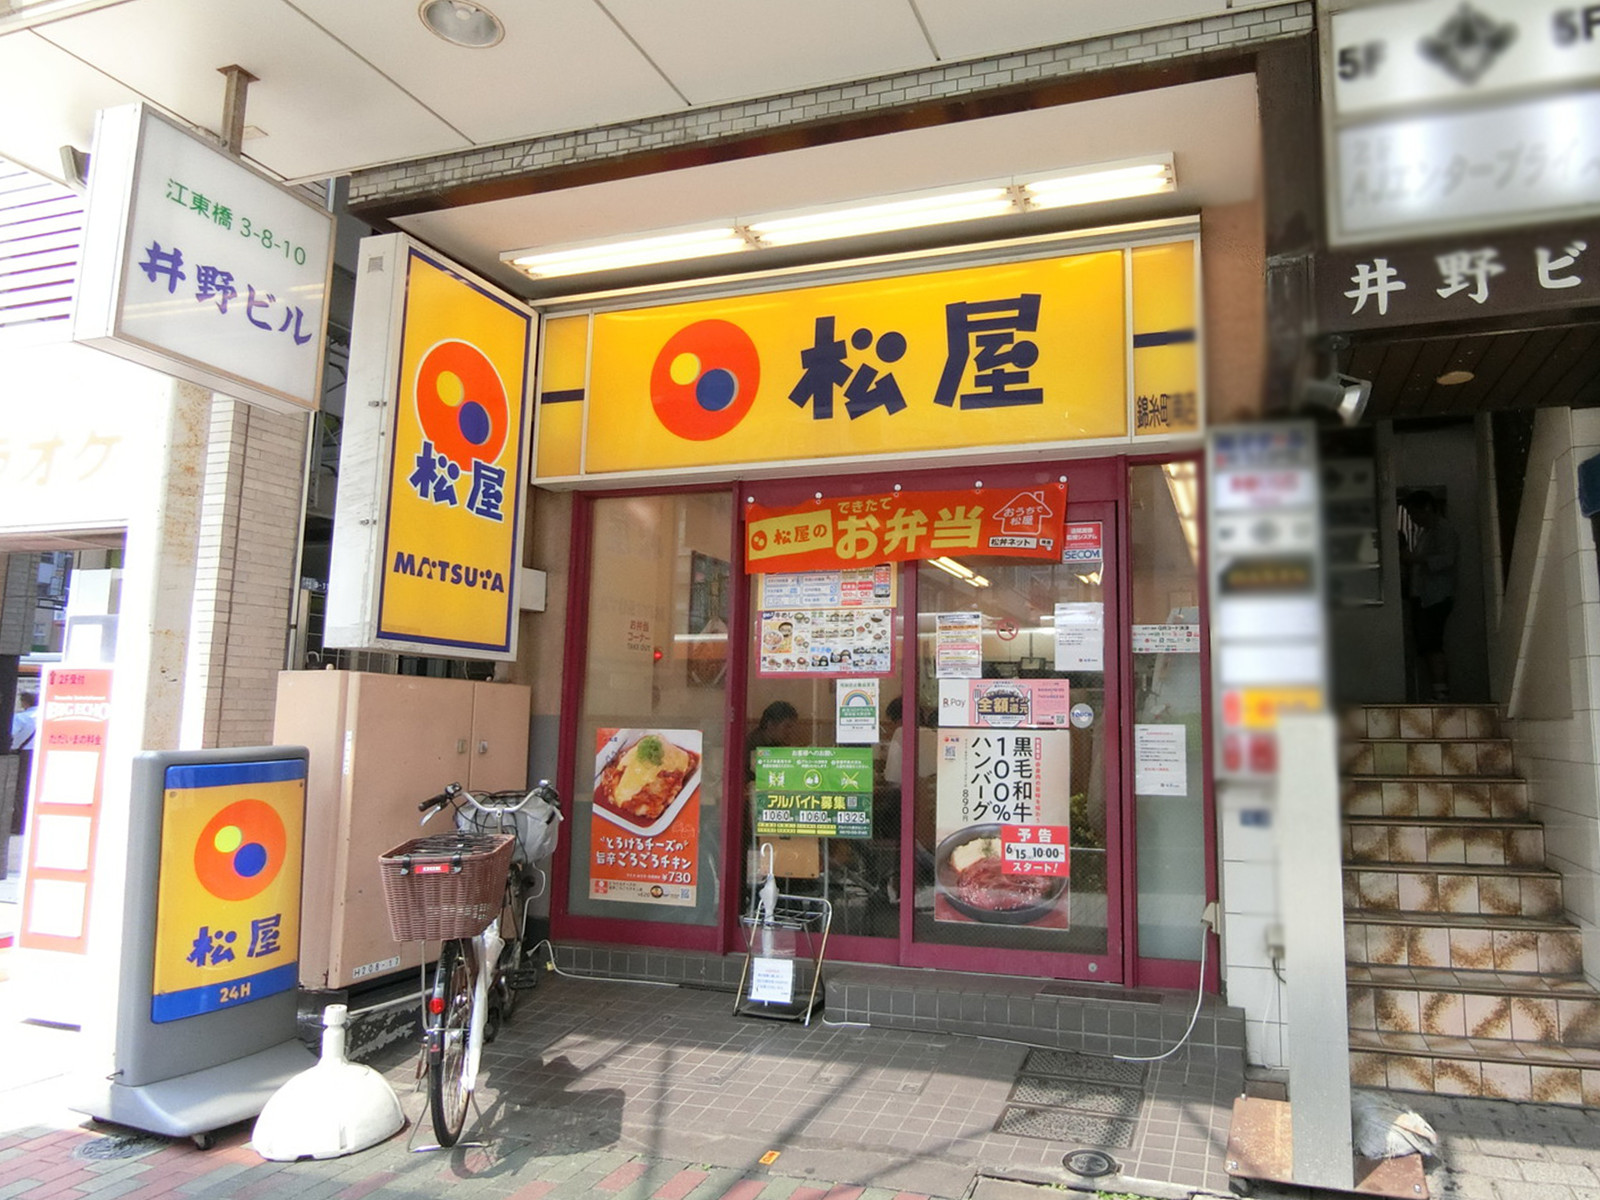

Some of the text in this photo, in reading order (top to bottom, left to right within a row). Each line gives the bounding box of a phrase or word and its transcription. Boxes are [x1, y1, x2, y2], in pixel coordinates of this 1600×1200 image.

[166, 178, 306, 265] 江東橋 3-8-10
[138, 240, 312, 345] 井野ビル
[788, 293, 1043, 420] 松屋
[408, 438, 506, 523] 松屋
[838, 497, 893, 514] できたて
[1003, 505, 1043, 518] おうちで
[773, 507, 985, 560] 松屋の お弁当
[393, 551, 505, 592] MATSUYA
[1064, 549, 1101, 560] SECOM
[971, 736, 993, 821] ハンバーグ
[992, 737, 1011, 821] 100%
[1013, 736, 1033, 823] 黒毛和牛
[767, 795, 846, 810] アルバイト募集
[1017, 828, 1052, 843] 予告
[596, 851, 692, 869] 旨辛ごろごろチキン
[662, 871, 691, 883] ¥730
[1012, 862, 1059, 873] スタート!
[187, 914, 282, 967] 松屋
[219, 982, 252, 1003] 24H
